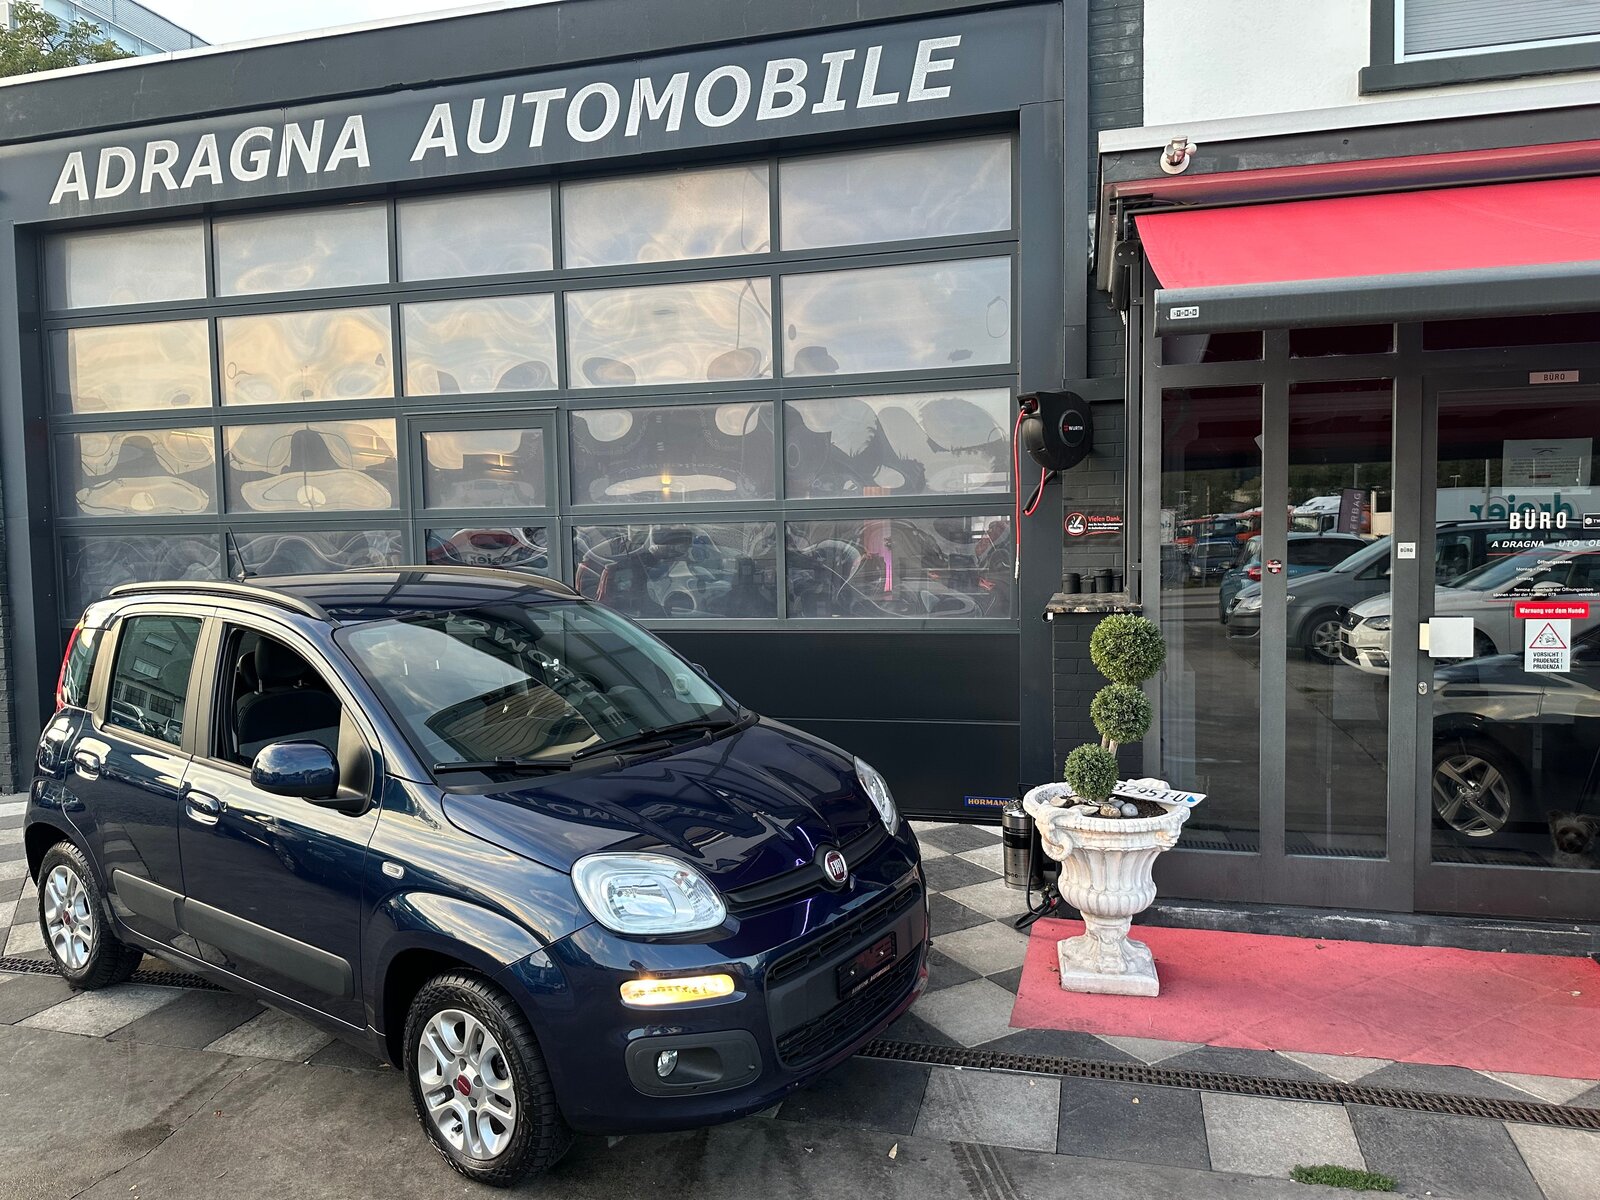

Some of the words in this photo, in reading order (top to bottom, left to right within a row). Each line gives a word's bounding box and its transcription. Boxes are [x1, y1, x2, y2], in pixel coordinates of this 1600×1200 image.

[49, 114, 370, 205] ADRAGNA
[410, 35, 961, 162] AUTOMOBILE
[1543, 372, 1566, 382] BÜRO
[1509, 508, 1567, 530] BÜRO
[830, 858, 844, 876] FIAT
